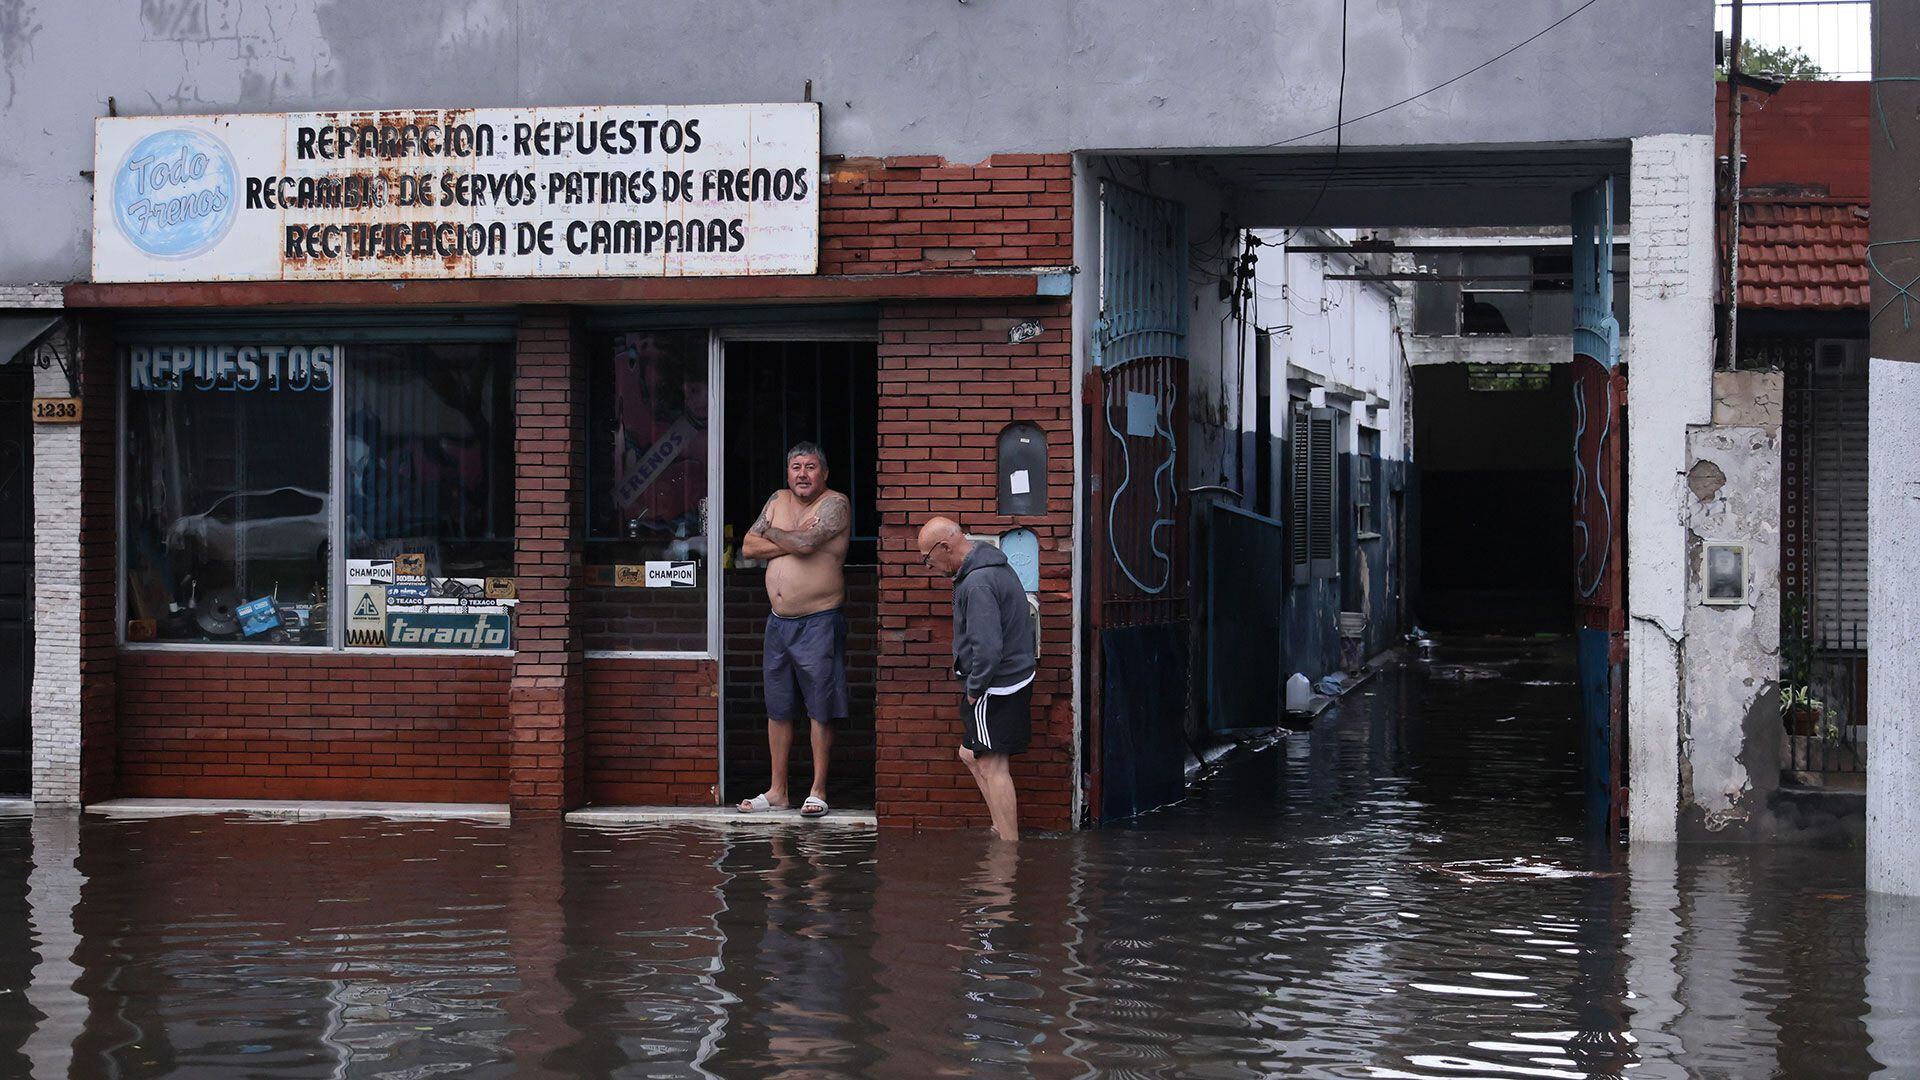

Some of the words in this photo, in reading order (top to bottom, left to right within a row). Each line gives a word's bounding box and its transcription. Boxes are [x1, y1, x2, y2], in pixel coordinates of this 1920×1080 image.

[514, 119, 701, 157] REPUESTOS
[128, 145, 210, 195] Todo
[400, 174, 432, 208] DE
[441, 172, 536, 207] SERVOS
[549, 170, 655, 205] PATINES
[663, 169, 694, 203] DE
[703, 167, 808, 202] FRENOS
[128, 186, 229, 234] Frenos
[285, 221, 506, 259] RECTIFICACION
[517, 220, 554, 256] DE
[567, 218, 745, 255] CAMPANAS
[130, 346, 333, 391] REPUESTOS
[36, 402, 77, 418] 1233
[350, 567, 392, 578] CHAMPION
[649, 570, 692, 579] CHAMPION
[391, 614, 505, 649] taranto
